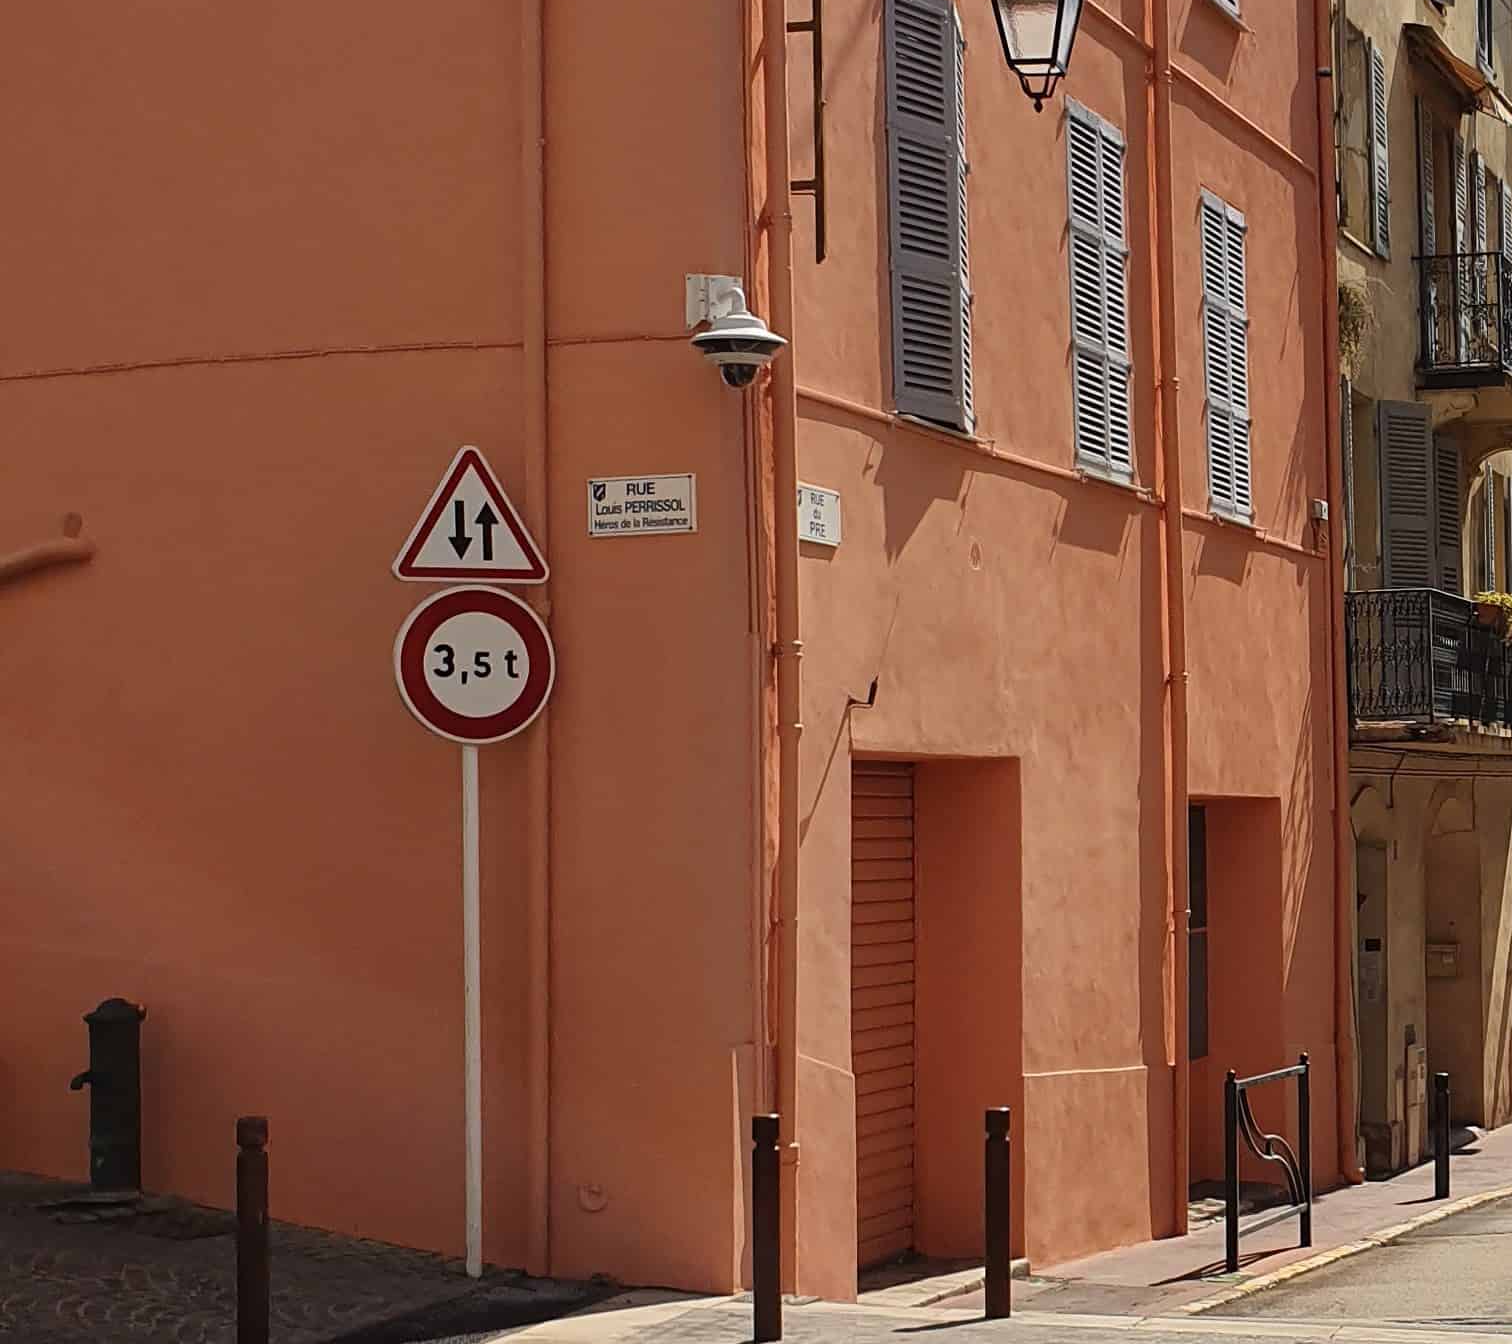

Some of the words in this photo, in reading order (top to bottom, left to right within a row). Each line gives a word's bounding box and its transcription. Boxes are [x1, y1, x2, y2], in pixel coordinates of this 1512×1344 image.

[626, 481, 656, 495] RUE
[596, 501, 622, 515] Louis
[625, 498, 685, 513] PERRISSOL
[810, 492, 825, 507] RUE
[812, 507, 822, 520] du
[620, 518, 631, 529] de
[633, 517, 641, 528] la
[433, 644, 491, 685] 3,5
[504, 650, 519, 678] t
